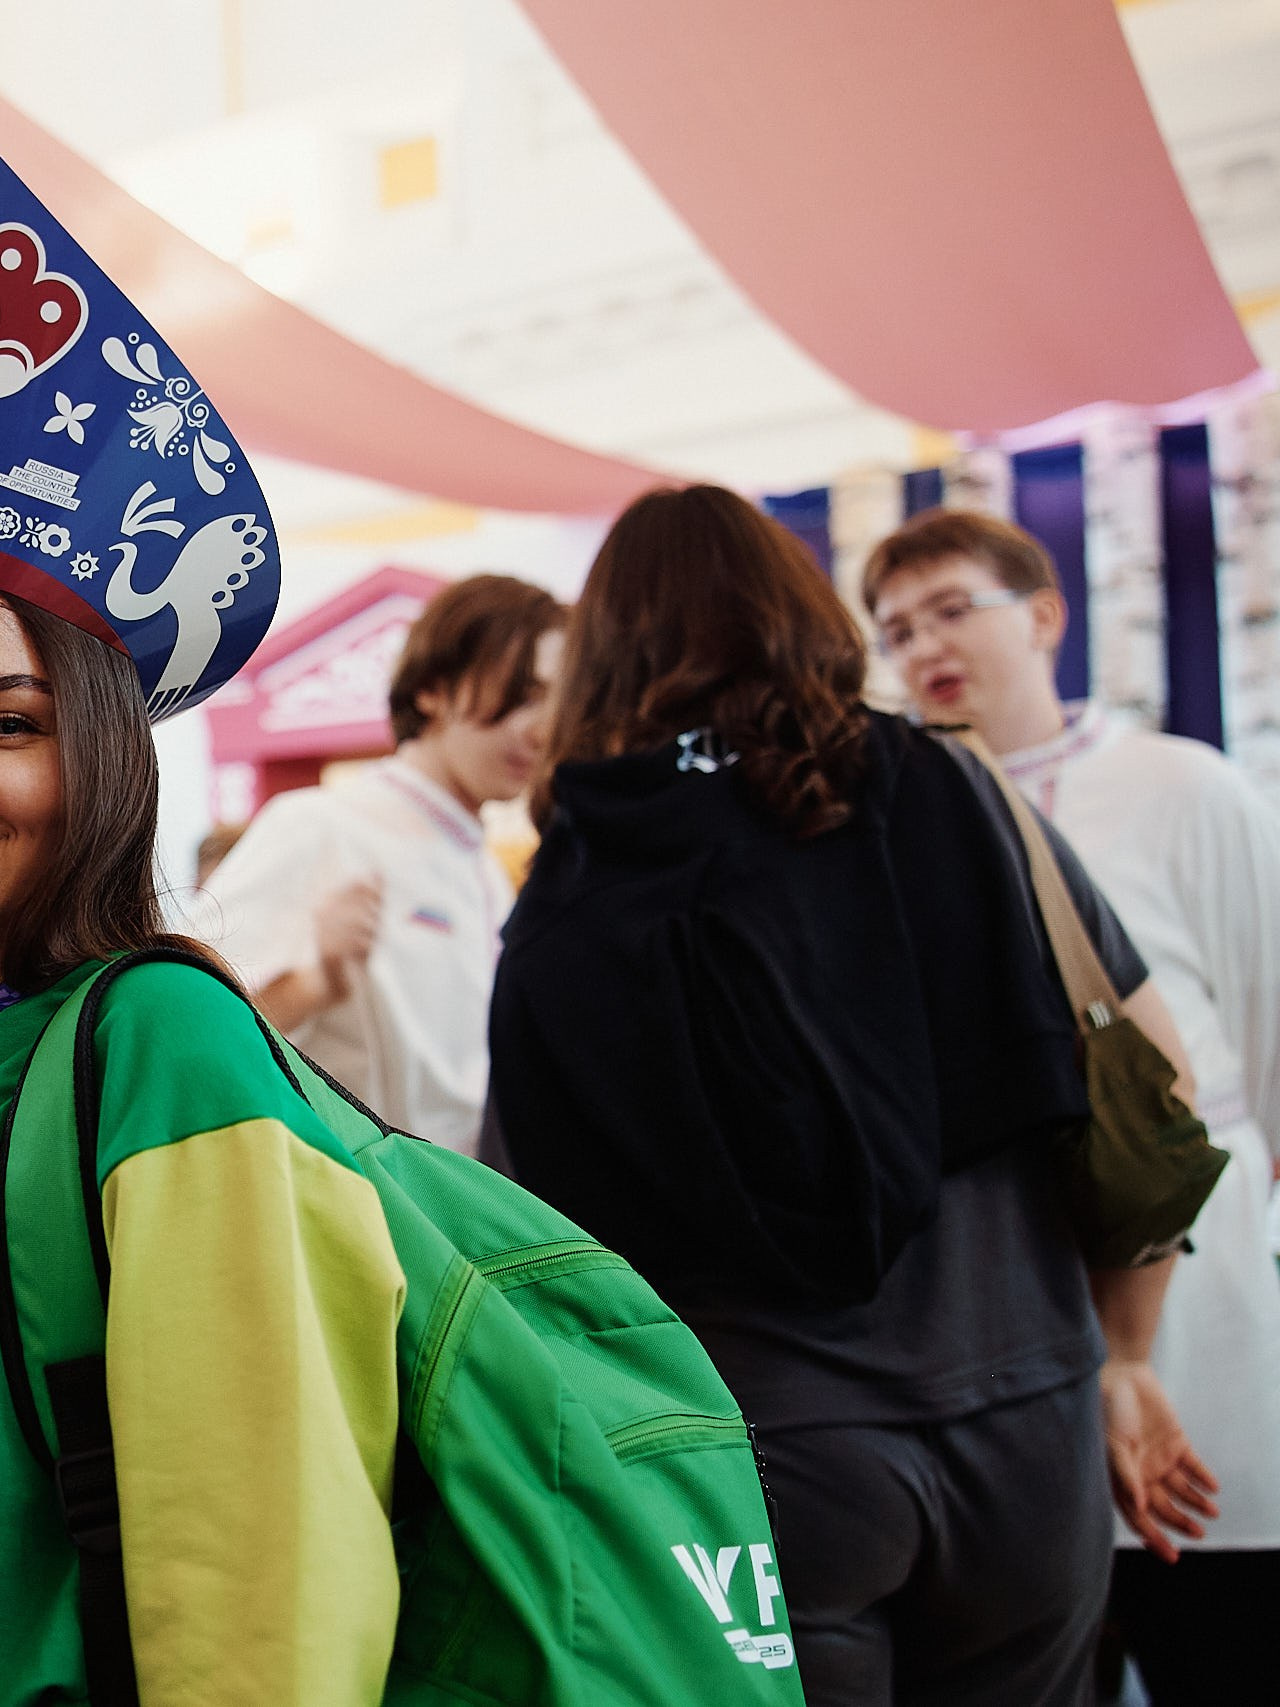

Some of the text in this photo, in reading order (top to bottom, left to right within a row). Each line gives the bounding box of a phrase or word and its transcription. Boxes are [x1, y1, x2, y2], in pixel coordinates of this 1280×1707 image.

[13, 469, 73, 494] THE COUNTRY
[28, 461, 64, 480] RUSSIA
[9, 480, 77, 508] OPPORTUNITIES
